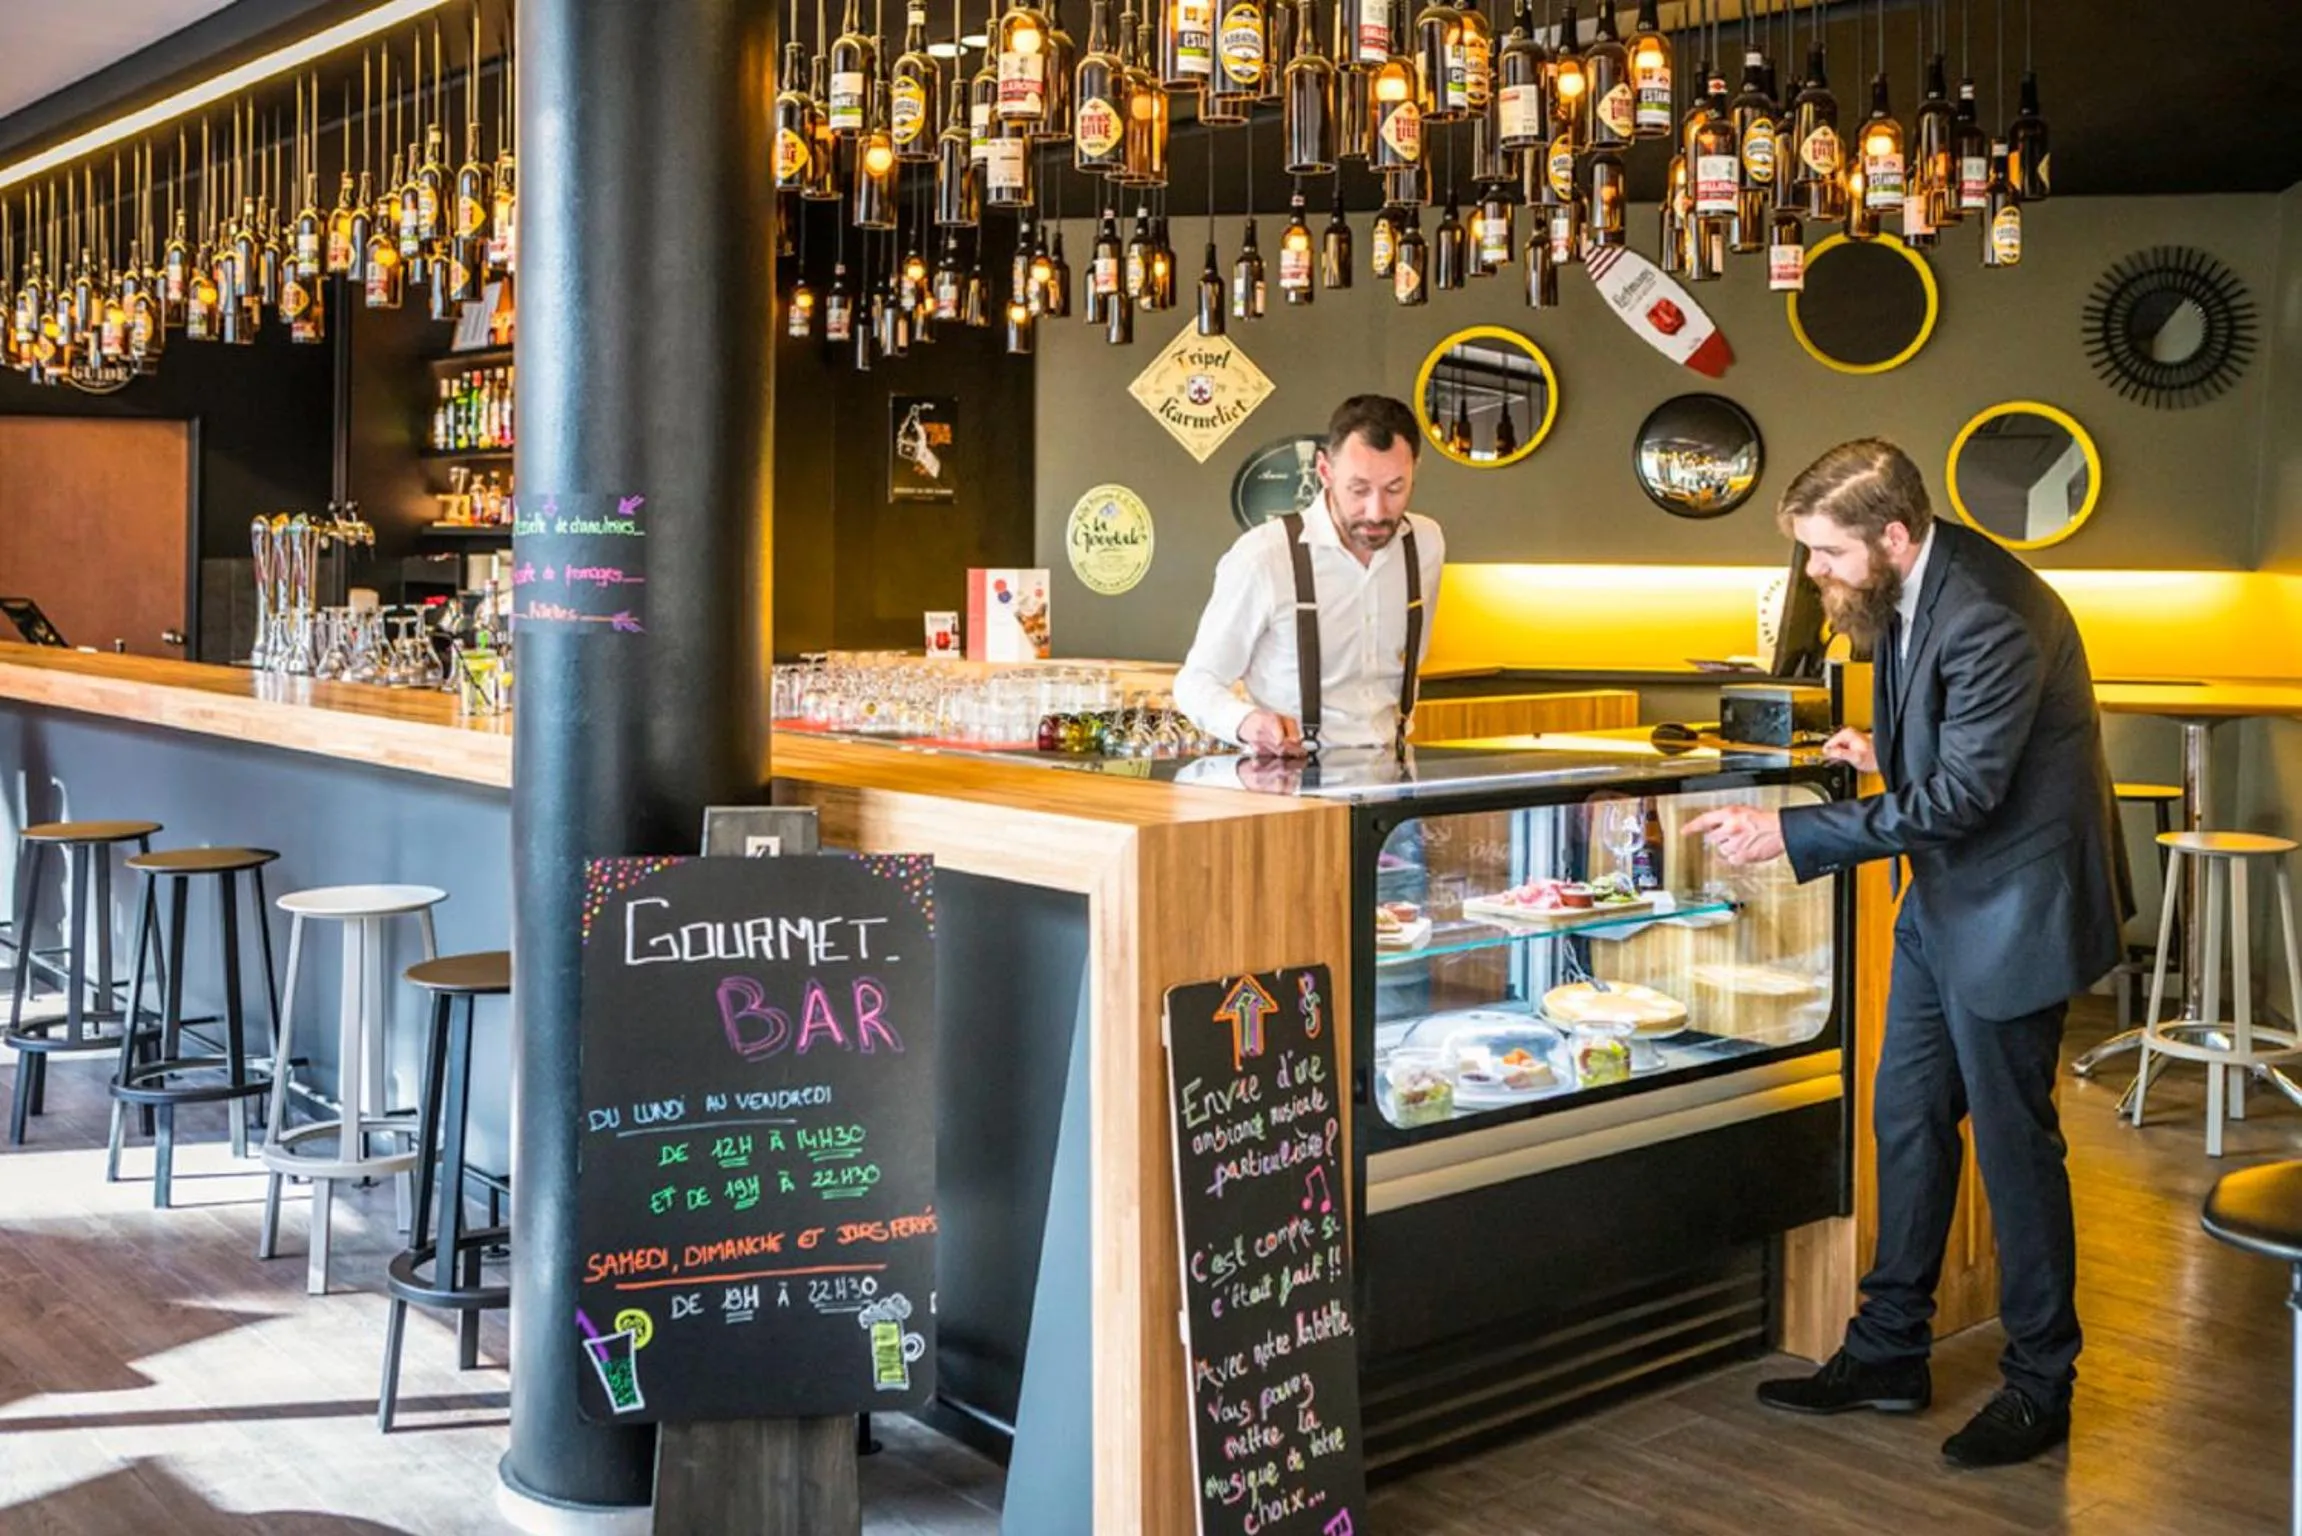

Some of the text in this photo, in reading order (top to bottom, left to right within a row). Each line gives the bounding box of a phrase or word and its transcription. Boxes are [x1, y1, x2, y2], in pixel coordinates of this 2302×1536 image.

[1172, 348, 1232, 369] Tripel
[716, 975, 905, 1062] BAR
[588, 1107, 621, 1132] DU
[706, 1093, 727, 1112] AU
[735, 1085, 832, 1111] VENDREDI
[1181, 1075, 1262, 1129] Envie
[658, 1142, 690, 1167] DE
[711, 1135, 752, 1158] 12H
[797, 1125, 866, 1150] 14H30
[650, 1187, 677, 1215] ET
[687, 1187, 711, 1210] DE
[724, 1174, 759, 1201] 19H
[810, 1164, 880, 1189] 22H30
[584, 1247, 679, 1283] SAMEDI,
[684, 1232, 785, 1268] DIMANCHE
[797, 1227, 826, 1249] ET
[670, 1293, 704, 1320] DE
[807, 1275, 878, 1302] 22H30
[1194, 1352, 1248, 1392] Avec
[1297, 1409, 1321, 1434] la
